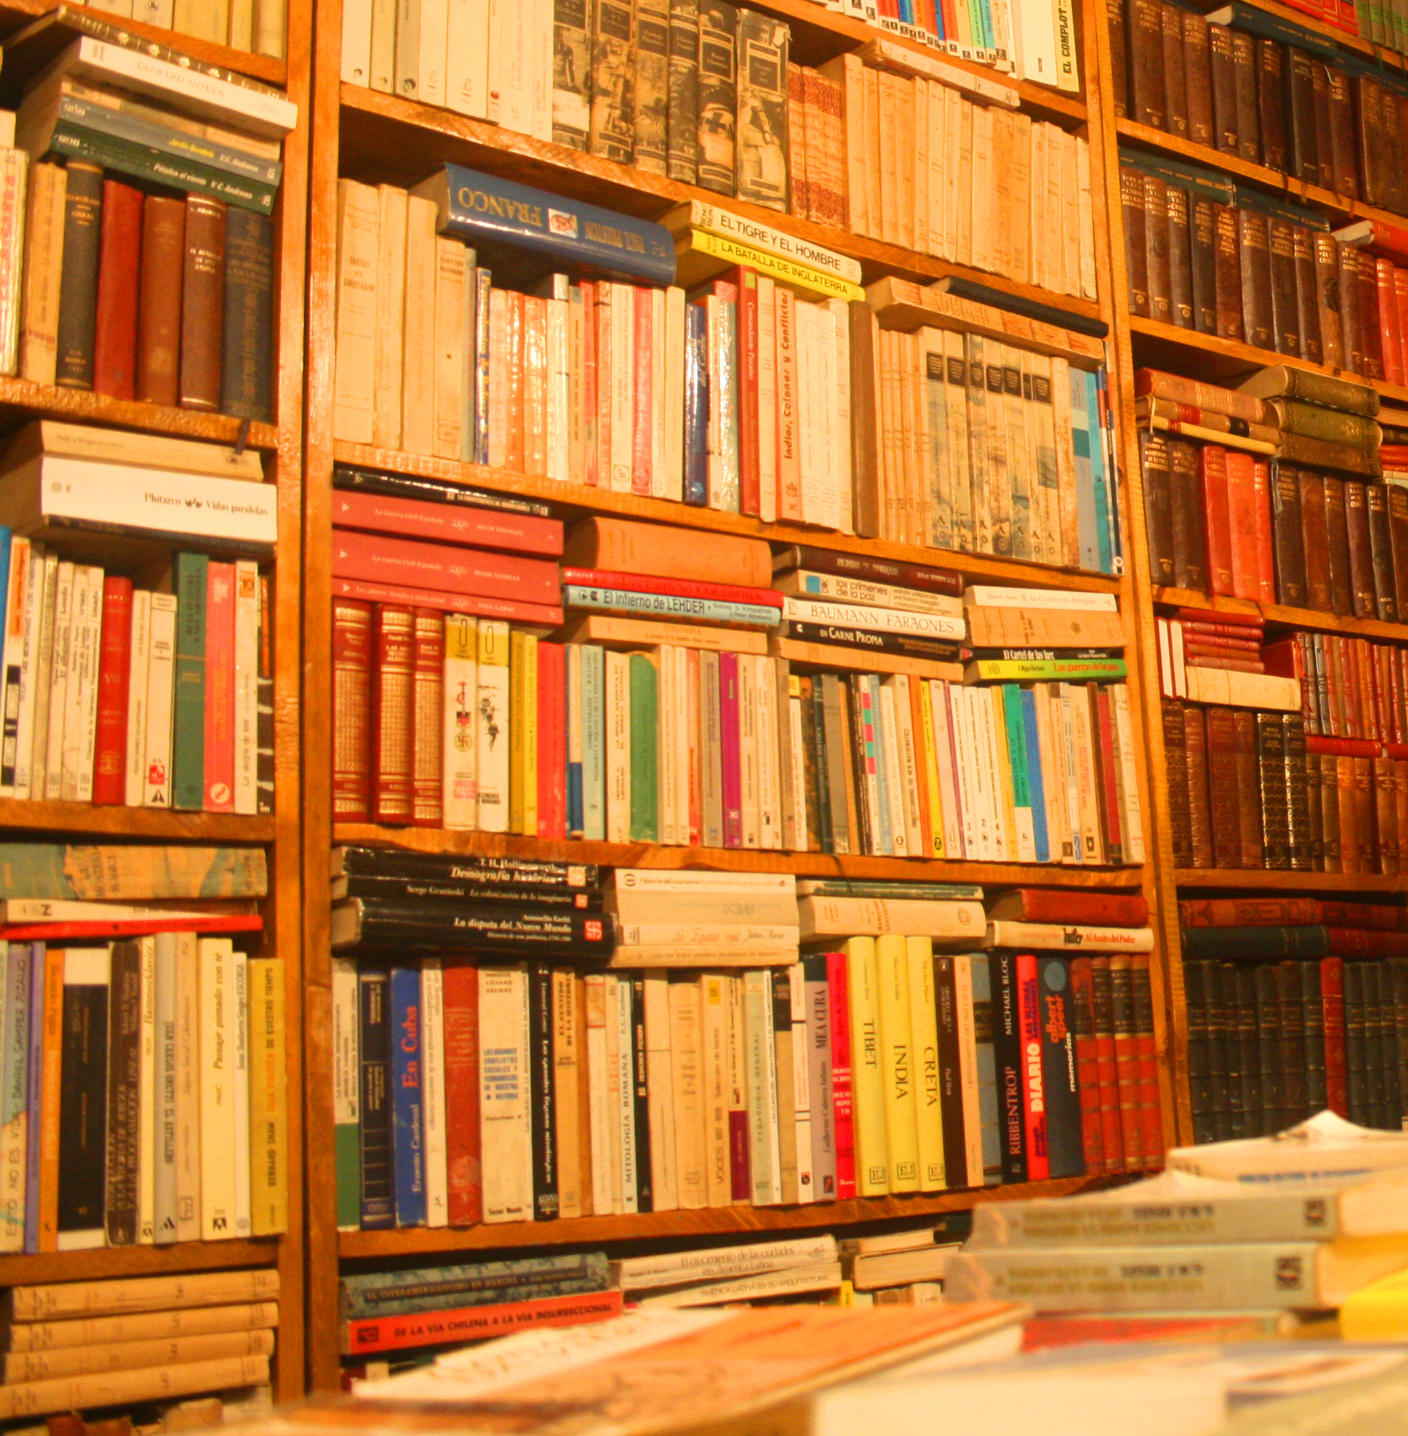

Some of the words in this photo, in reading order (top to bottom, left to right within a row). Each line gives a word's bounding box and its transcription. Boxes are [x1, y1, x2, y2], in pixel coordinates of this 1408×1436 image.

[1058, 7, 1070, 57] COMPLOT
[1063, 61, 1072, 74] EL
[457, 187, 543, 228] FRANCO
[720, 215, 733, 230] EL
[736, 220, 770, 243] TIGRE
[771, 233, 778, 244] Y
[780, 236, 792, 252] EL
[796, 243, 841, 271] HOMBRE
[721, 243, 733, 254] LA
[736, 247, 775, 269] BATALLA
[777, 262, 790, 273] DE
[792, 264, 849, 293] INGLATERRA
[779, 292, 790, 350] Conflictos
[144, 492, 182, 505] Plutarco
[206, 499, 229, 511] Vidas
[231, 501, 268, 516] paralelas
[603, 591, 614, 604] El
[615, 591, 651, 608] Infierno
[653, 596, 665, 609] de
[667, 597, 706, 615] LEHDER
[836, 578, 849, 589] los
[811, 604, 879, 625] BAUMANN
[886, 613, 954, 633] FARAONES
[454, 917, 466, 927] La
[468, 918, 498, 931] disputa
[500, 919, 513, 930] del
[516, 921, 541, 932] Nuevo
[543, 923, 573, 934] Mundo
[215, 965, 223, 985] con
[212, 988, 224, 1028] pintado
[814, 989, 826, 1023] CUBA
[1001, 987, 1012, 1036] MICHAEL
[1045, 996, 1058, 1043] albert
[13, 1008, 25, 1053] SAMPER
[401, 1005, 418, 1053] Cuba
[815, 1025, 827, 1050] MEA
[863, 1018, 876, 1068] TIBET
[11, 1060, 23, 1100] DANIEL
[402, 1061, 419, 1089] En
[621, 1053, 630, 1108] ROMANA
[893, 1045, 910, 1100] INDIA
[924, 1047, 938, 1107] CRETA
[1027, 1042, 1044, 1113] DIARIO
[1066, 1032, 1075, 1093] memorias
[411, 1104, 419, 1149] Cardenal
[1005, 1066, 1021, 1156] RIBBENTROP
[8, 1147, 20, 1164] ES
[412, 1153, 421, 1192] Ernesto
[8, 1172, 19, 1190] NO
[394, 1327, 406, 1337] DE
[411, 1325, 423, 1335] LA
[427, 1323, 445, 1334] VIA
[448, 1319, 488, 1331] CHILENA
[492, 1318, 499, 1326] A
[503, 1315, 514, 1325] LA
[516, 1313, 533, 1324] VIA
[536, 1304, 612, 1320] INSURRECCIONAL
